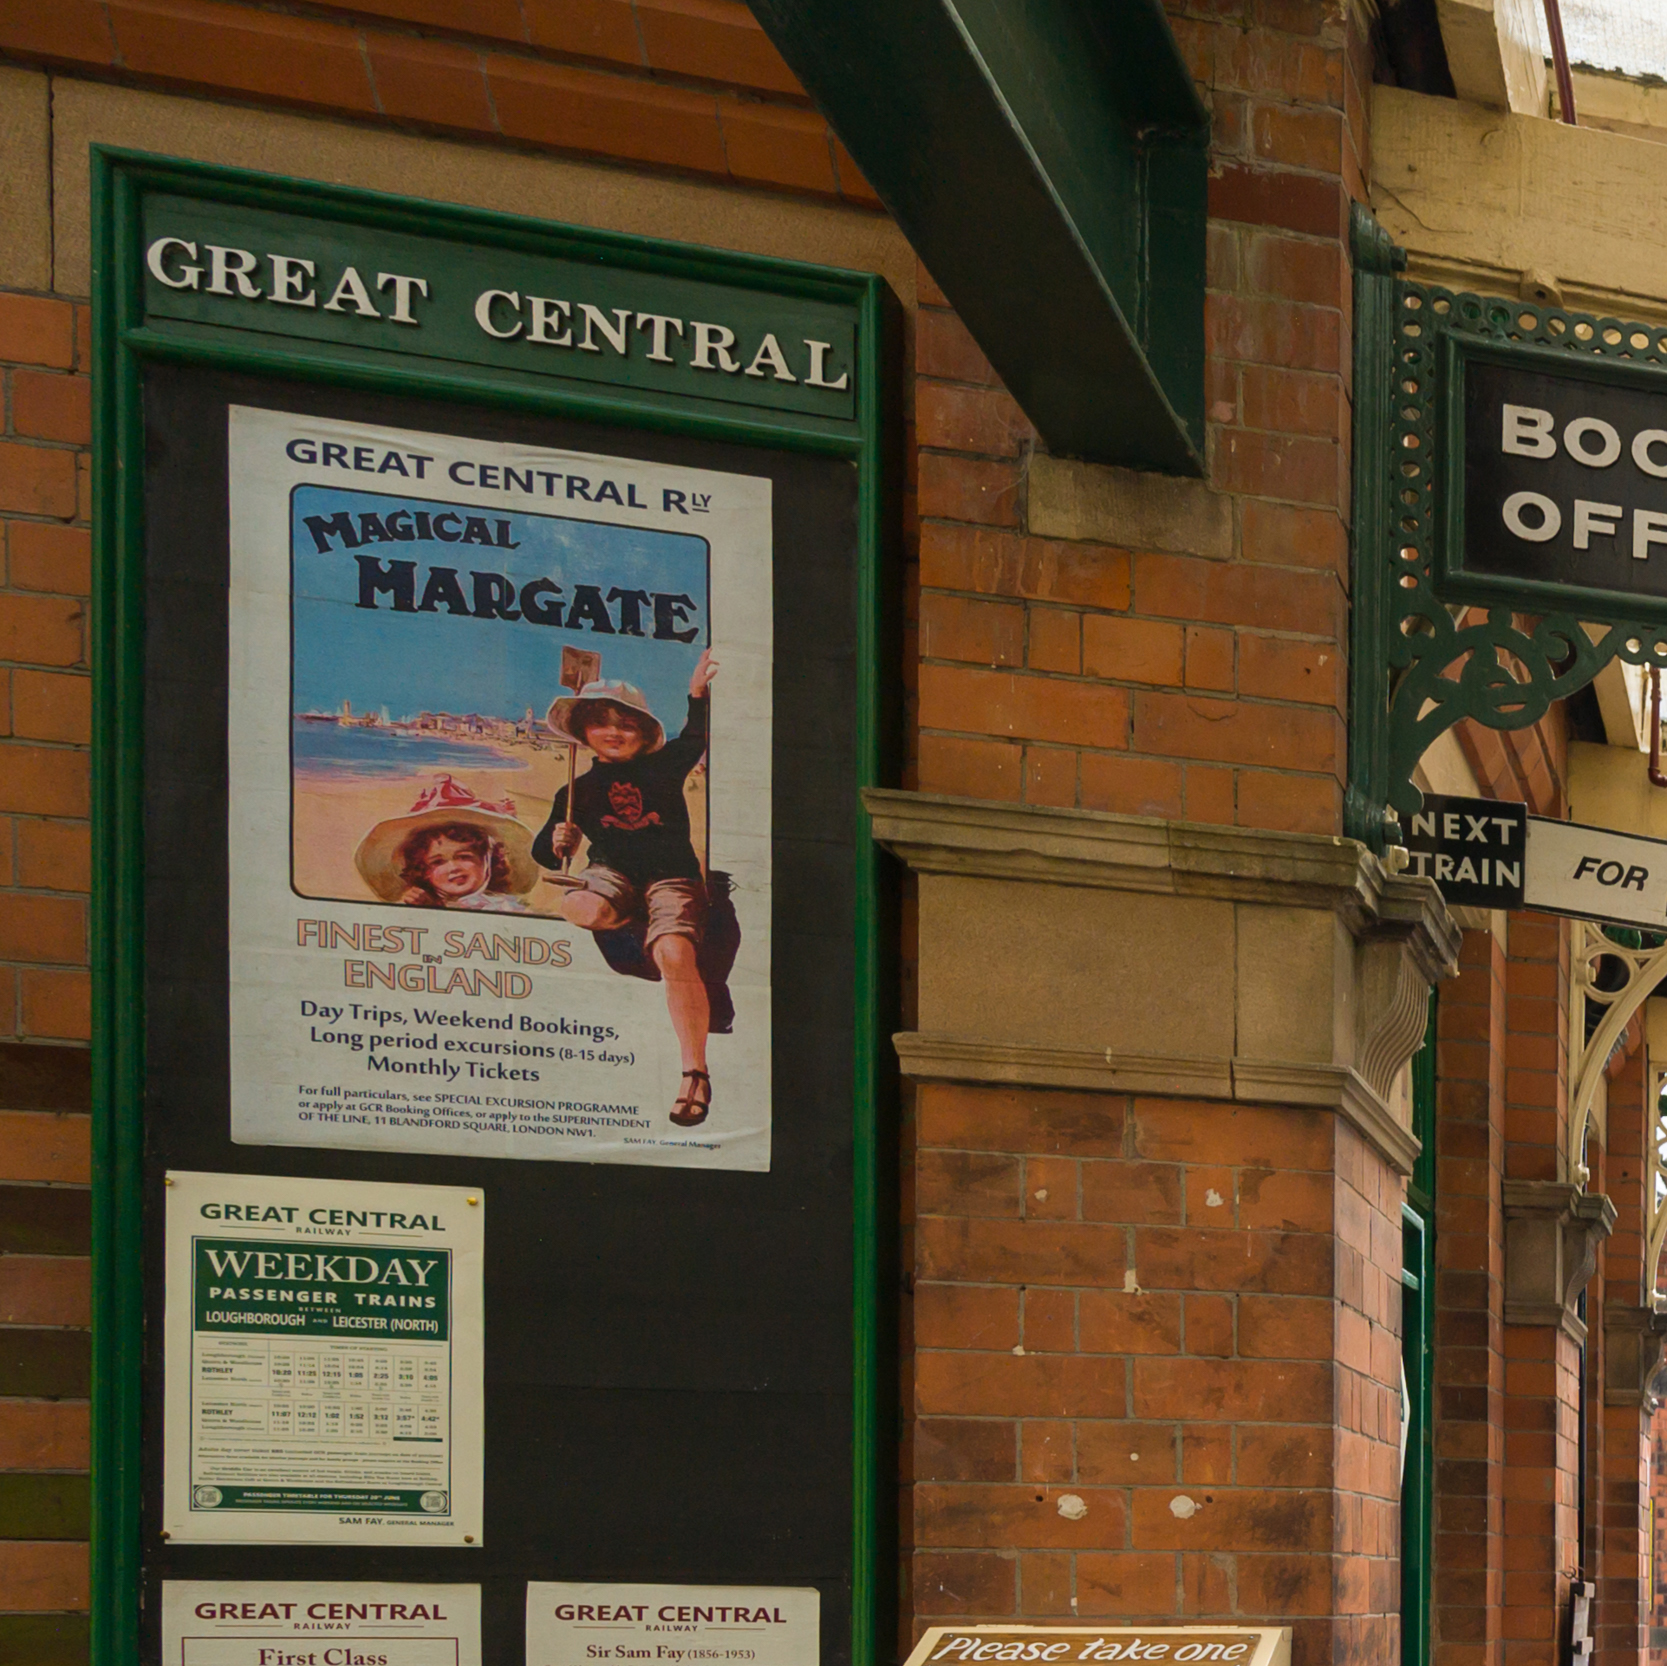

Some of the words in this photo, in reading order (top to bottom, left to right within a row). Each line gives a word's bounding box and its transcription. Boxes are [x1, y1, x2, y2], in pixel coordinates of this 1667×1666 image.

[146, 236, 429, 325] GREAT
[474, 289, 849, 390] CENTRAL
[285, 438, 434, 480] GREAT
[447, 460, 649, 510] CENTRAL
[302, 508, 521, 554] MAGICAL
[354, 554, 703, 644] MARGATE
[1411, 811, 1518, 845] NEXT
[1410, 851, 1521, 888] TRAIN
[1573, 856, 1650, 891] FOR
[297, 918, 429, 954] FINEST
[444, 930, 572, 967] SANDS
[422, 954, 442, 964] IN
[344, 959, 533, 999] ENGLAND
[301, 1000, 344, 1025] Day
[349, 1003, 408, 1028] Trips,
[413, 1008, 513, 1030] Weekend
[520, 1016, 620, 1043] Bookings,
[311, 1026, 364, 1051] Long
[370, 1032, 438, 1052] period
[444, 1040, 555, 1058] excursions
[559, 1047, 595, 1061] (8-15
[598, 1051, 635, 1066] days)
[368, 1055, 460, 1082] Monthly
[465, 1061, 540, 1082] Tickets
[299, 1085, 318, 1095] For
[321, 1086, 341, 1096] full
[344, 1089, 410, 1101] particulars,
[413, 1094, 432, 1102] see
[434, 1093, 482, 1105] SPECIAL
[485, 1096, 555, 1110] EXCURSION
[558, 1101, 639, 1115] PROGRAMME
[298, 1112, 315, 1120] OF
[318, 1112, 340, 1122] THE
[375, 1116, 386, 1125] 11
[389, 1117, 460, 1129] BLANDFORD
[463, 1121, 510, 1133] SQUARE,
[513, 1125, 564, 1135] LONDON
[312, 1101, 343, 1112] apply
[345, 1103, 356, 1111] at
[359, 1102, 383, 1112] GCR
[386, 1104, 430, 1118] Booking
[432, 1107, 473, 1118] Offices,
[489, 1111, 517, 1123] apply
[520, 1113, 530, 1121] to
[533, 1113, 550, 1122] the
[552, 1114, 651, 1128] SUPERINTENDENT
[688, 1141, 721, 1150] Manager
[200, 1203, 299, 1223] GREAT
[308, 1208, 446, 1231] CENTRAL
[296, 1227, 351, 1236] RAILWAY
[204, 1249, 438, 1286] WEEKDAY
[209, 1287, 338, 1303] PASSENGER
[354, 1293, 436, 1308] TRAINS
[206, 1311, 306, 1326] LOUGHBOROUGH
[333, 1316, 387, 1330] LEICESTER
[391, 1318, 439, 1334] (NORTH)
[195, 1603, 298, 1620] GREAT
[307, 1603, 447, 1620] CENTRAL
[555, 1604, 649, 1621] GREAT
[658, 1606, 787, 1623] CENTRAL
[258, 1648, 317, 1666] First
[324, 1648, 388, 1666] Class
[586, 1645, 611, 1658] Sir
[615, 1645, 651, 1658] Sam
[656, 1645, 685, 1662] Fay
[688, 1649, 756, 1660] (1856-1953)
[931, 1637, 1071, 1661] Please
[1077, 1637, 1170, 1661] take
[1174, 1643, 1249, 1661] one
